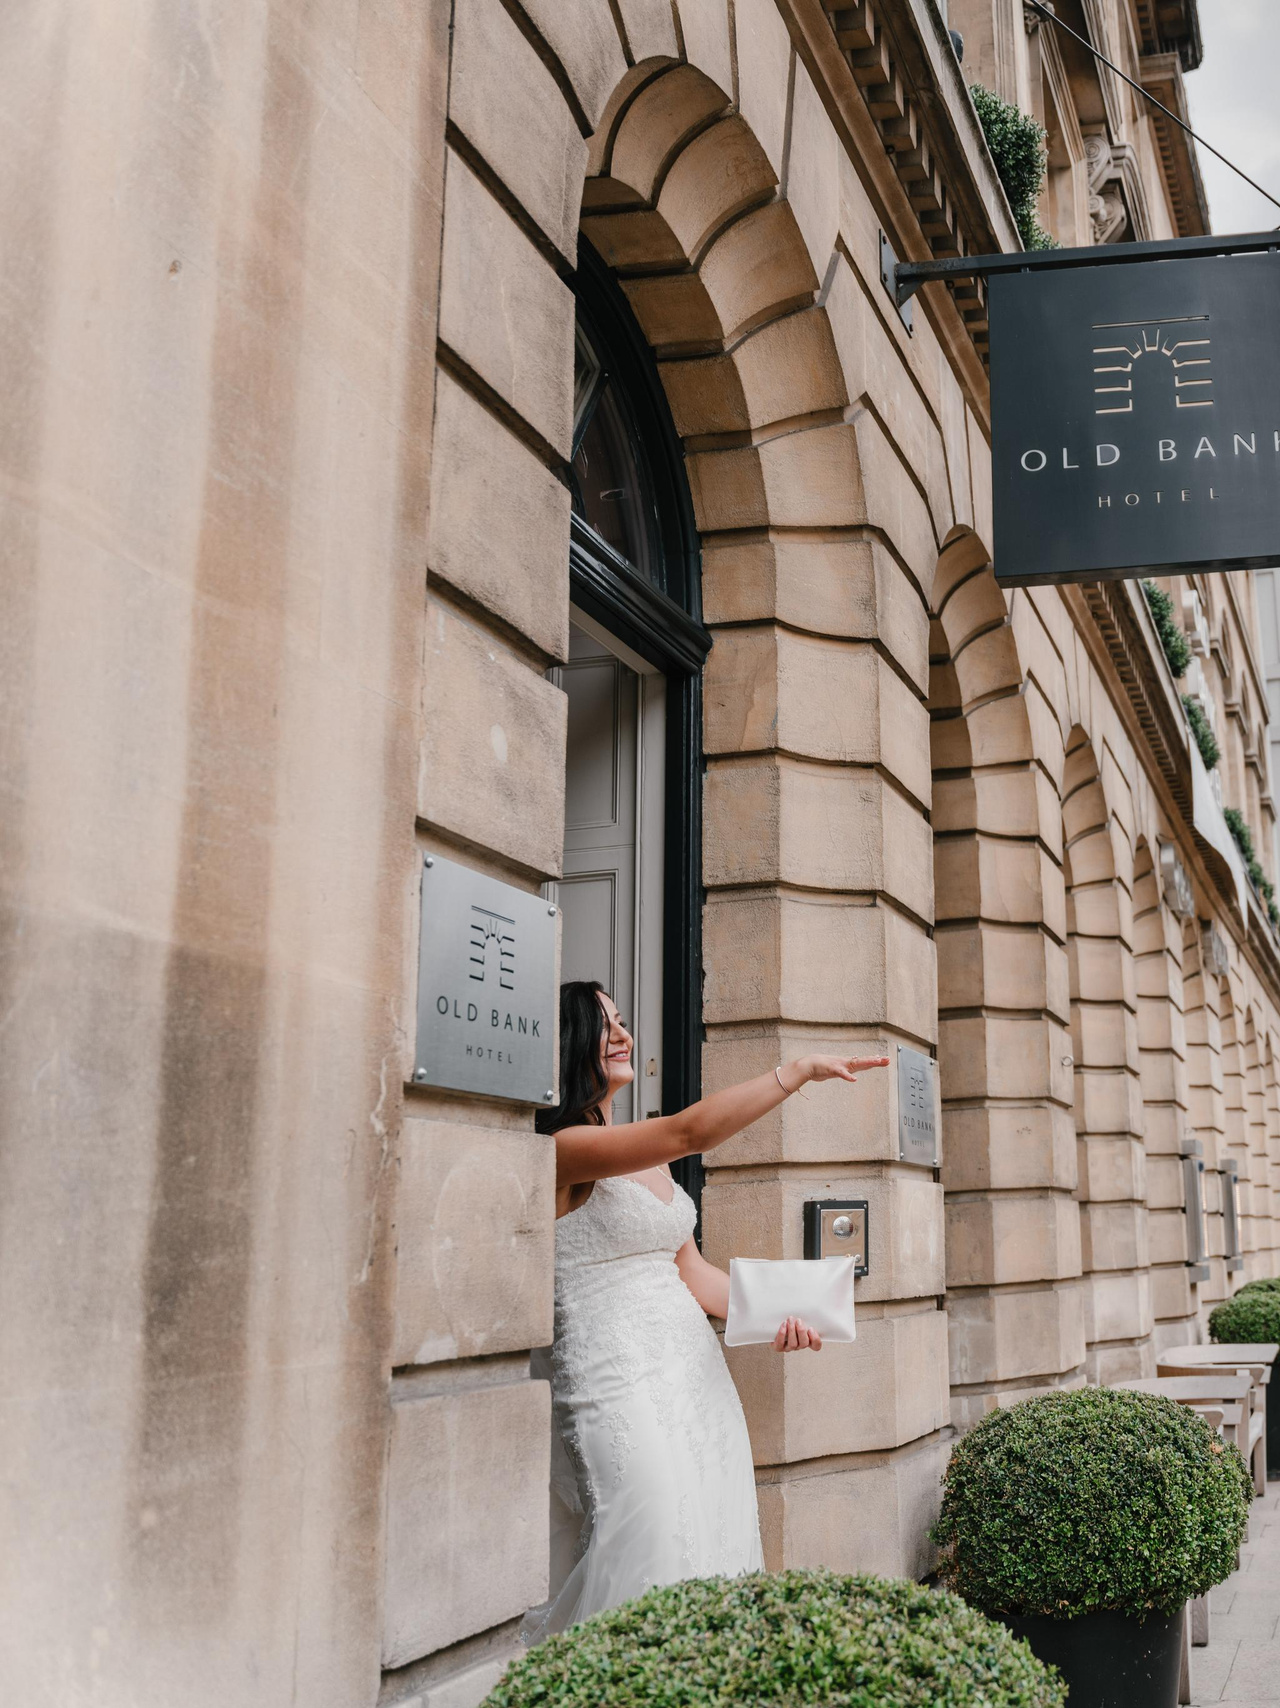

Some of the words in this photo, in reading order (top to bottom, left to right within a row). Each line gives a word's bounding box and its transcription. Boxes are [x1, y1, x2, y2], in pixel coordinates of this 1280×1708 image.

[1020, 443, 1121, 471] OLD
[1098, 487, 1220, 508] HOTEL
[436, 995, 478, 1022] OLD
[491, 1009, 540, 1038] BANK
[466, 1044, 513, 1064] HOTEL
[903, 1115, 915, 1128] OLD
[917, 1119, 932, 1131] BANK
